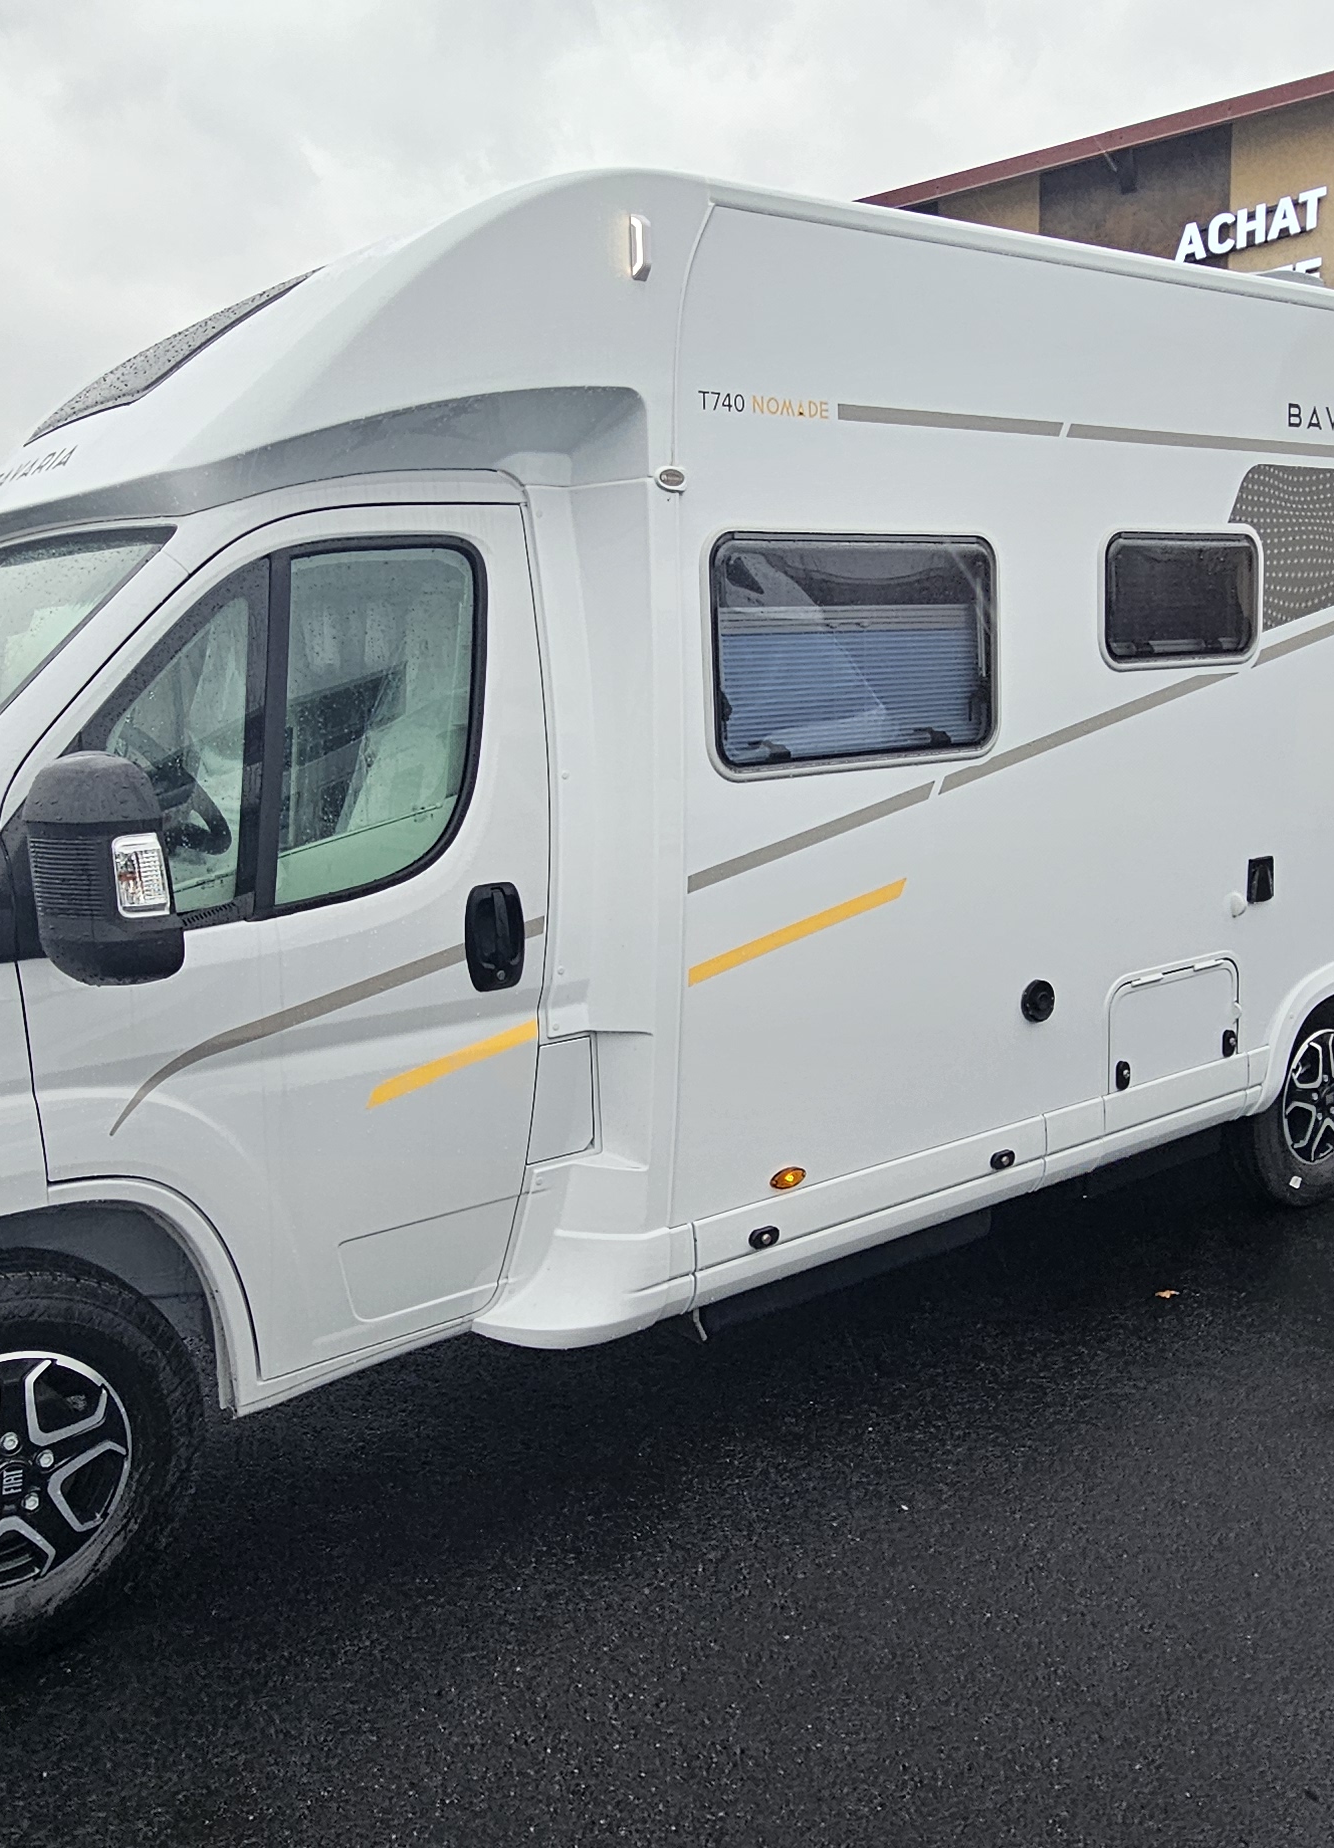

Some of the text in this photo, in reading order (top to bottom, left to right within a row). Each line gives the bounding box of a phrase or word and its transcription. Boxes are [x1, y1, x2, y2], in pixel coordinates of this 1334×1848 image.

[1175, 186, 1327, 263] ACHAT
[697, 390, 829, 419] T740 NOMADE
[1, 1469, 23, 1495] FIAT
